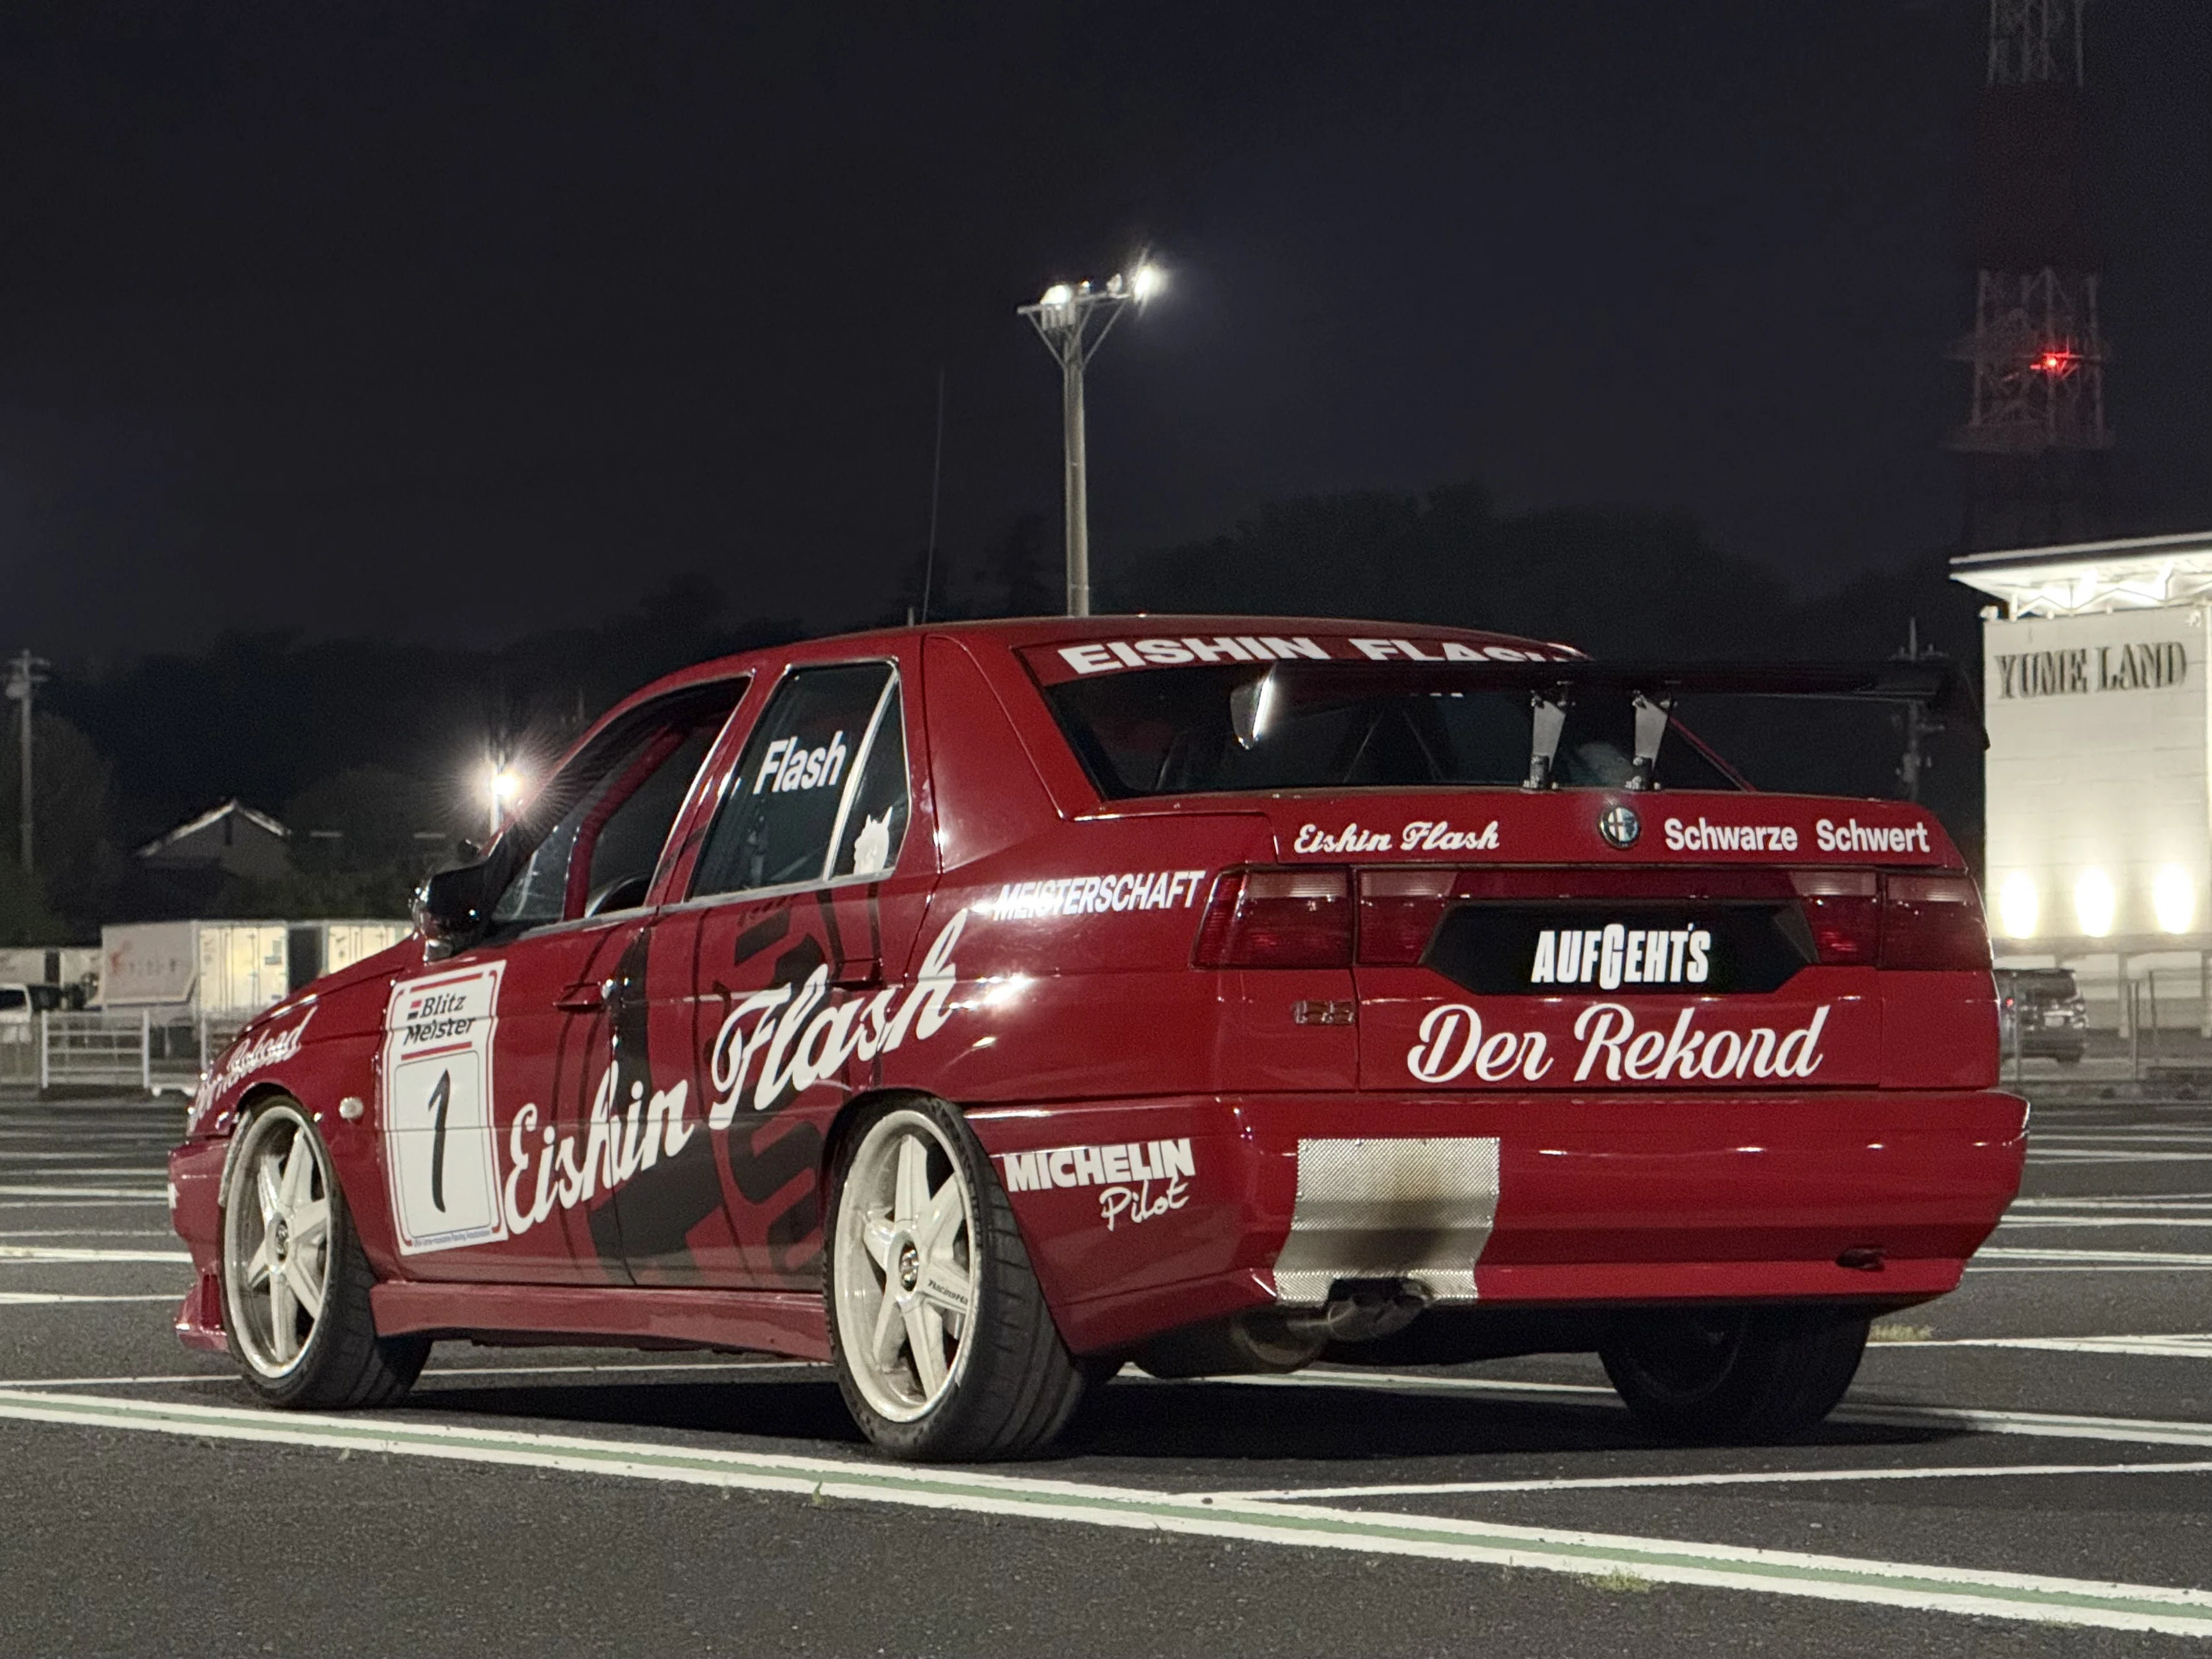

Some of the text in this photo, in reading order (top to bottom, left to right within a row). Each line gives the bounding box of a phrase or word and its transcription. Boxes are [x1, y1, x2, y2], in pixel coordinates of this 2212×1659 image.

[1057, 637, 1331, 674] EISHIN
[1995, 641, 2187, 699] YUME LAND
[753, 730, 846, 794] Flash
[1294, 820, 1500, 853] Eishin Flash
[1664, 817, 1931, 853] Schwarze Schwert
[993, 870, 1206, 921] MEISTERSCHAFT
[403, 1017, 476, 1045] Meister
[420, 993, 467, 1018] Blitz
[1407, 1004, 1554, 1082] Der
[504, 908, 968, 1235] Eishin Flash
[428, 1069, 451, 1213] 1
[1003, 1138, 1196, 1192] MICHELIN
[1100, 1176, 1189, 1231] Pilot
